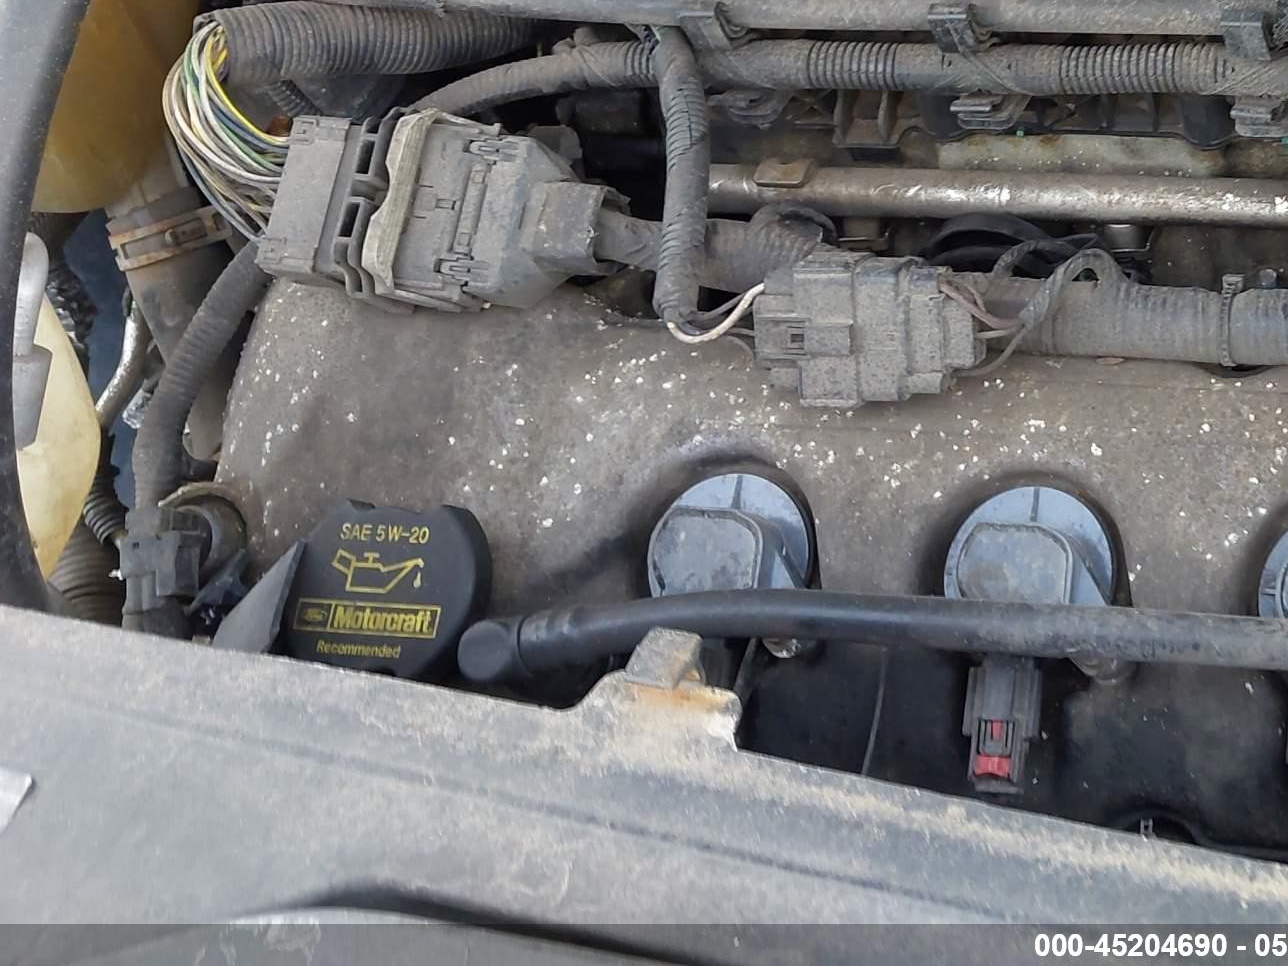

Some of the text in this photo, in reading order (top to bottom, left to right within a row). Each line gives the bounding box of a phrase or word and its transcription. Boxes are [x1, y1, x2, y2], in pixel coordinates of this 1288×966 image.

[340, 522, 430, 545] SAE 5W-20
[333, 606, 432, 634] Motorcraft
[316, 640, 401, 659] Recommended
